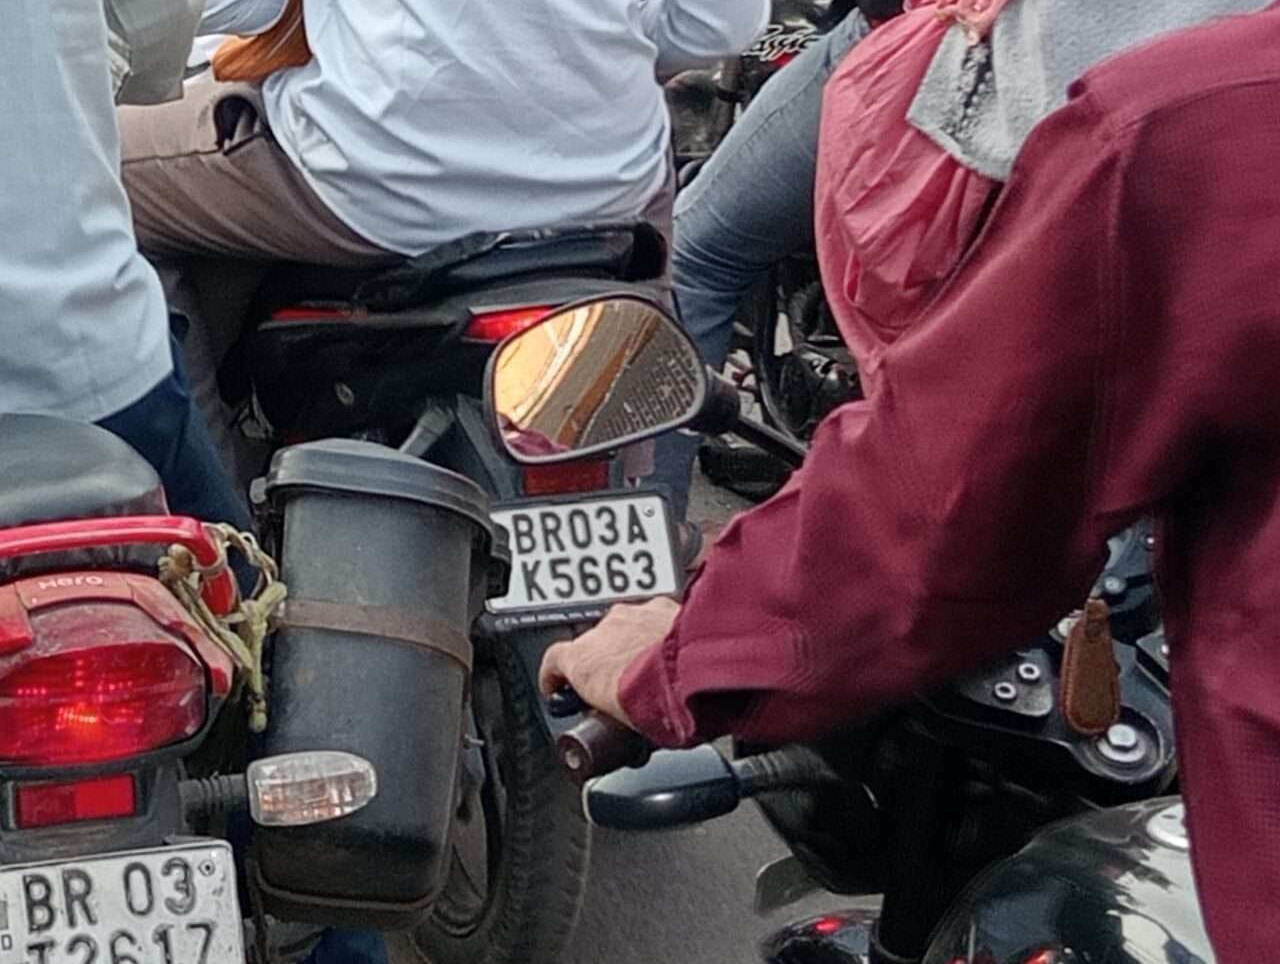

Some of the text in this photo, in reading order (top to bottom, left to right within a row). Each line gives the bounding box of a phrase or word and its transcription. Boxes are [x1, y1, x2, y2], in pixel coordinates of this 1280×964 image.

[512, 503, 648, 555] BR03A
[521, 550, 657, 602] K5663
[22, 856, 197, 935] BR 03
